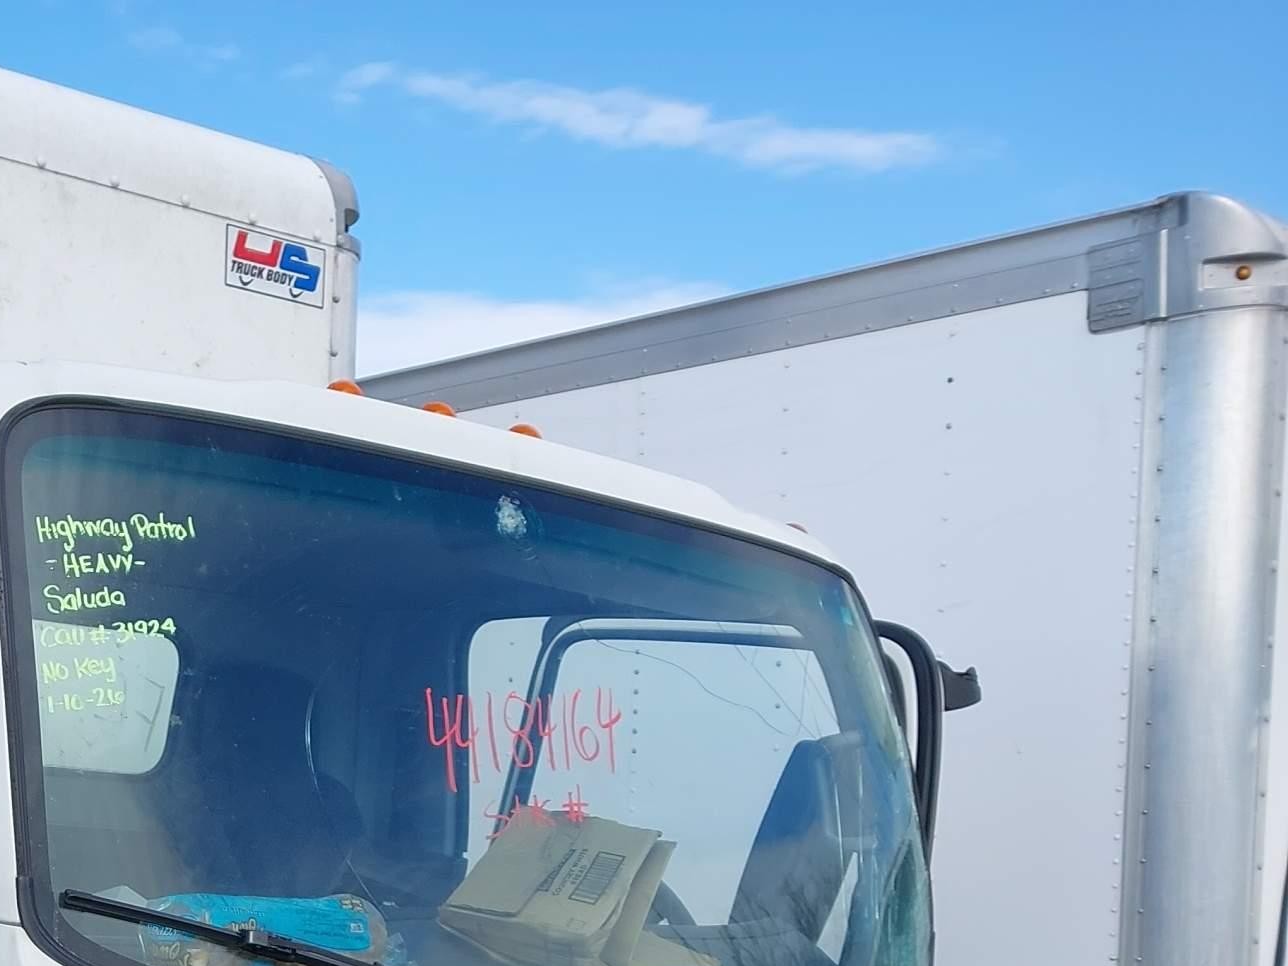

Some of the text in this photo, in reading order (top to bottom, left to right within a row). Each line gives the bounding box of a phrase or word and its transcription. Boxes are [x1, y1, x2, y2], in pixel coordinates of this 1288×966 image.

[231, 260, 295, 287] TRUCK BODY
[233, 230, 321, 292] US
[36, 512, 196, 551] Highway Patrol
[43, 585, 126, 614] Saluda
[425, 687, 621, 793] 44184164
